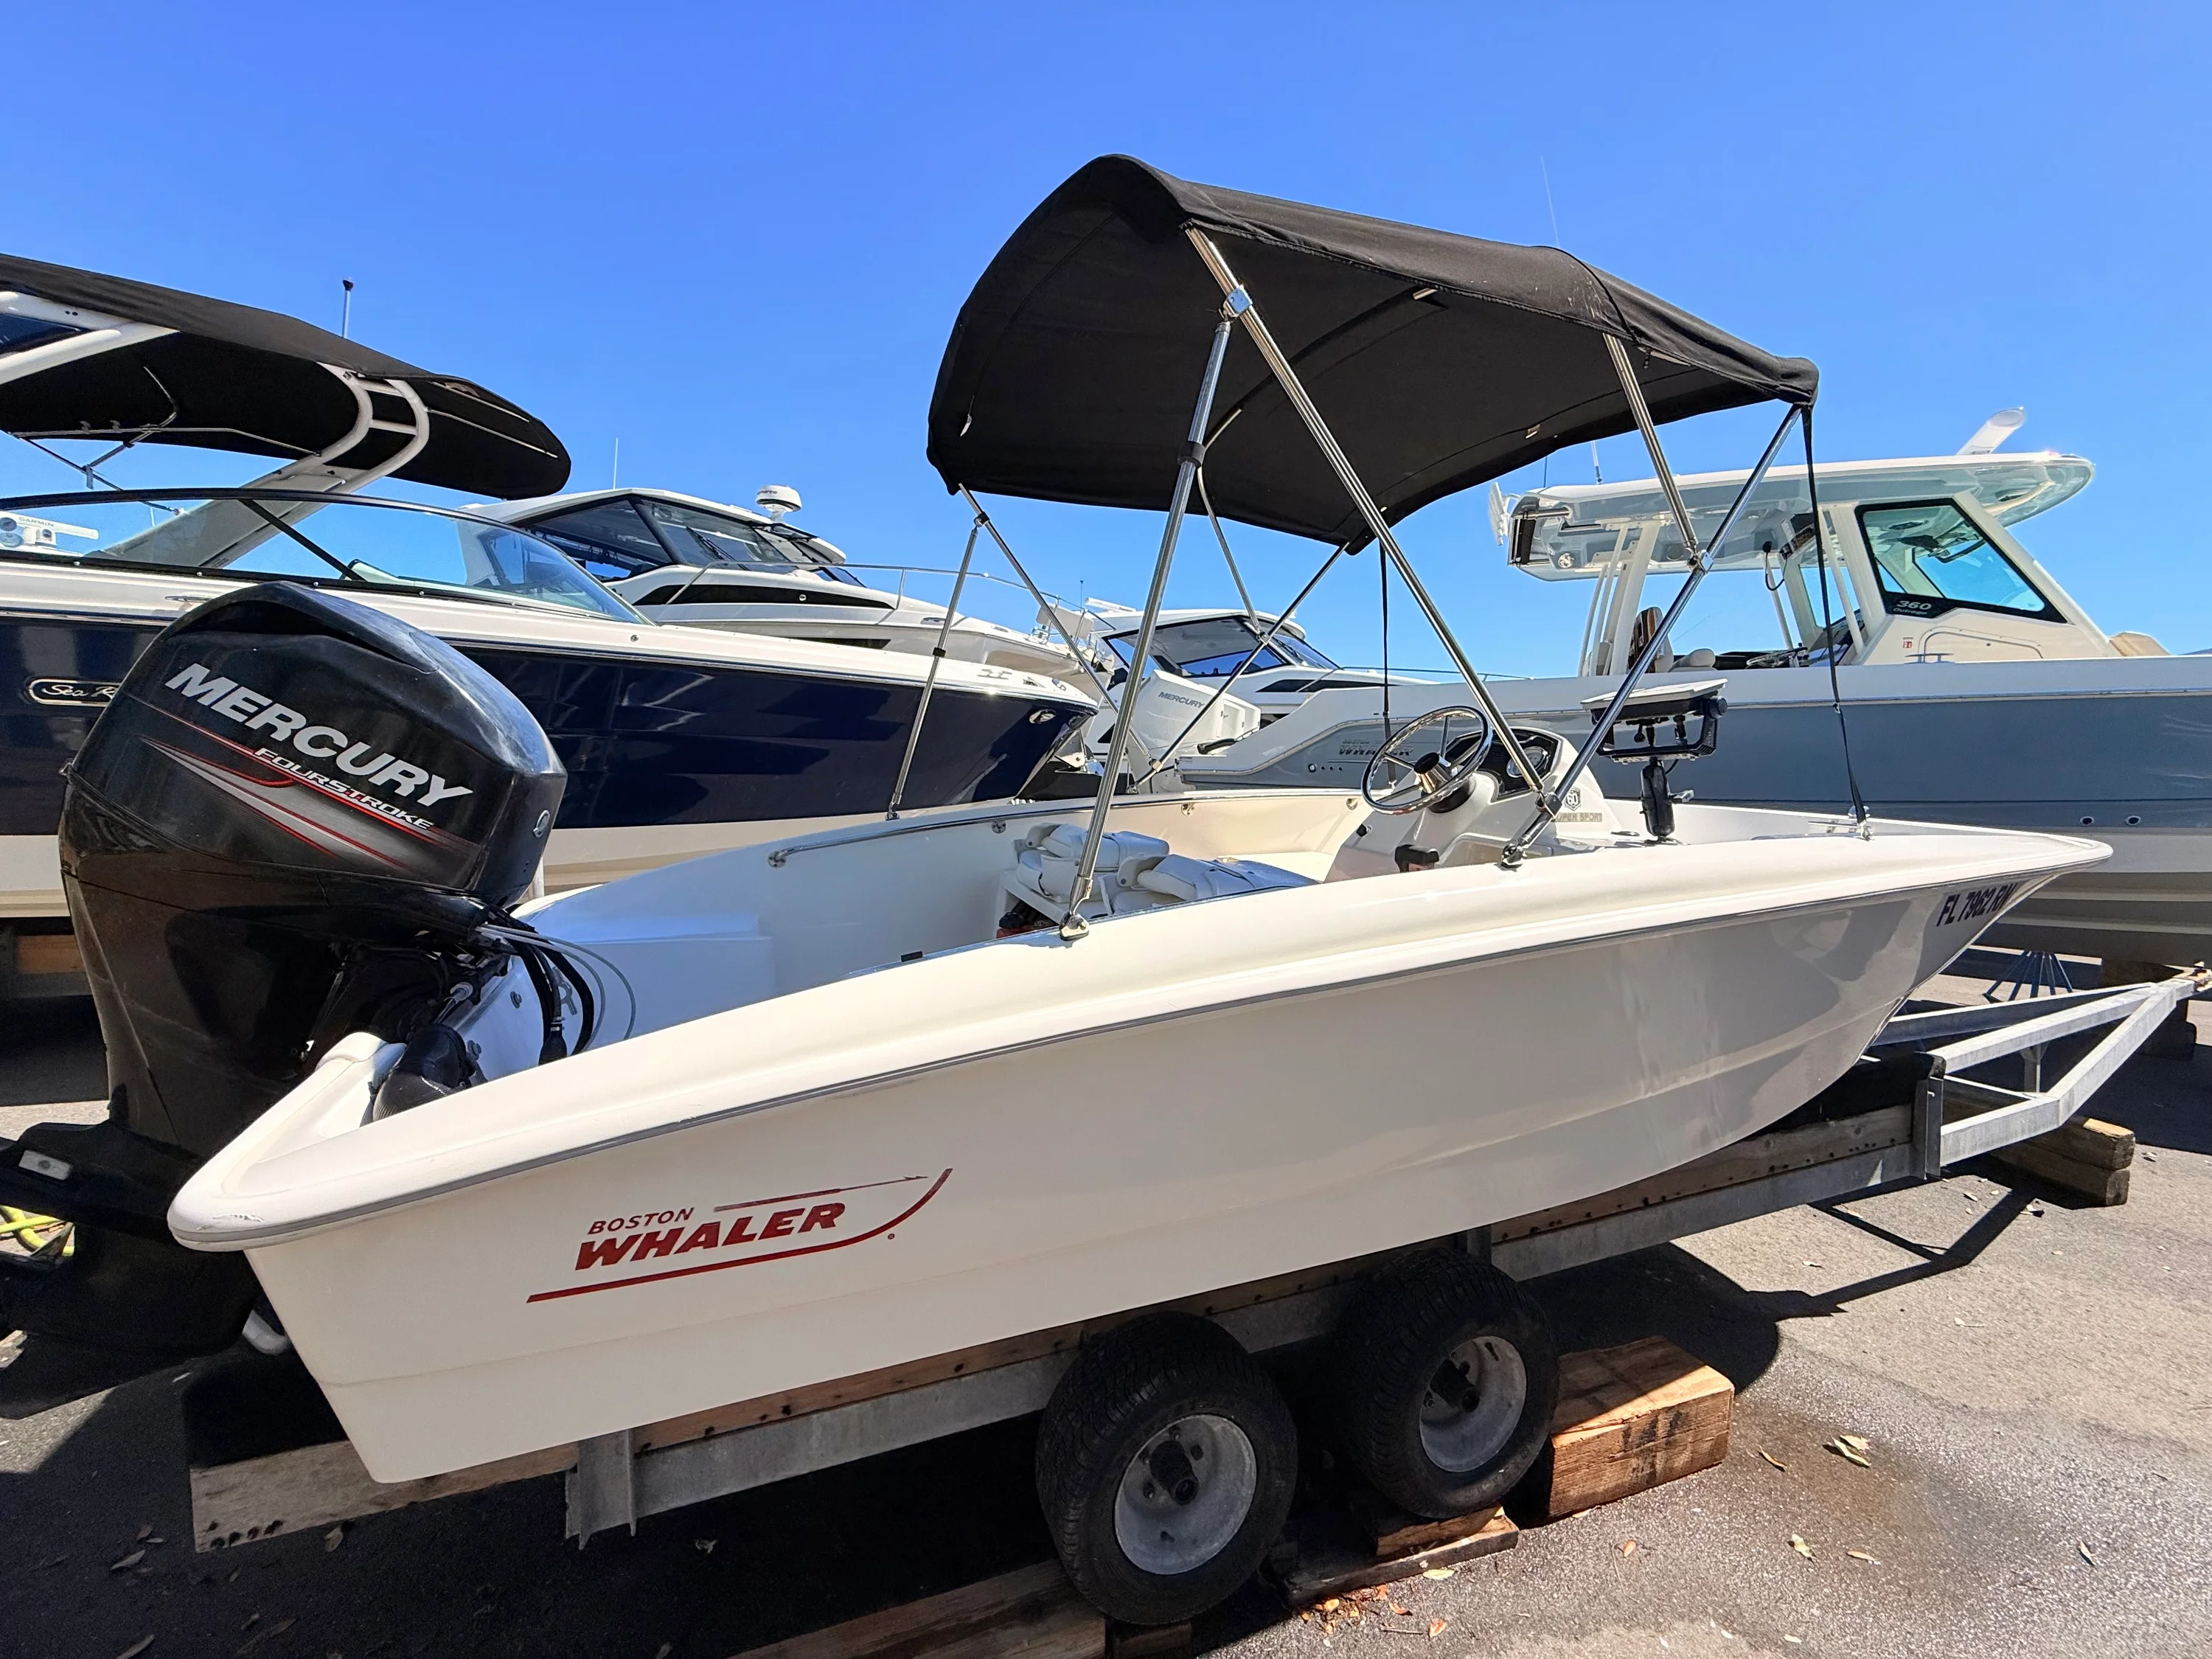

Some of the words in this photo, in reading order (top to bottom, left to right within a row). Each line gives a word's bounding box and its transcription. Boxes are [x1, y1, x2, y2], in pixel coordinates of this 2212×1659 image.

[18, 517, 54, 527] GARMIN
[1896, 600, 1932, 610] 360
[41, 684, 89, 697] Sea
[1158, 692, 1205, 709] MERCURY
[164, 662, 473, 807] MERCURY
[253, 747, 438, 830] FOURSTROKE
[1566, 793, 1579, 805] 60
[1555, 813, 1578, 822] UPER
[1579, 813, 1602, 822] SPORT
[1936, 894, 1961, 927] FL
[588, 1207, 695, 1234] BOSTON
[575, 1203, 846, 1270] WHALER
